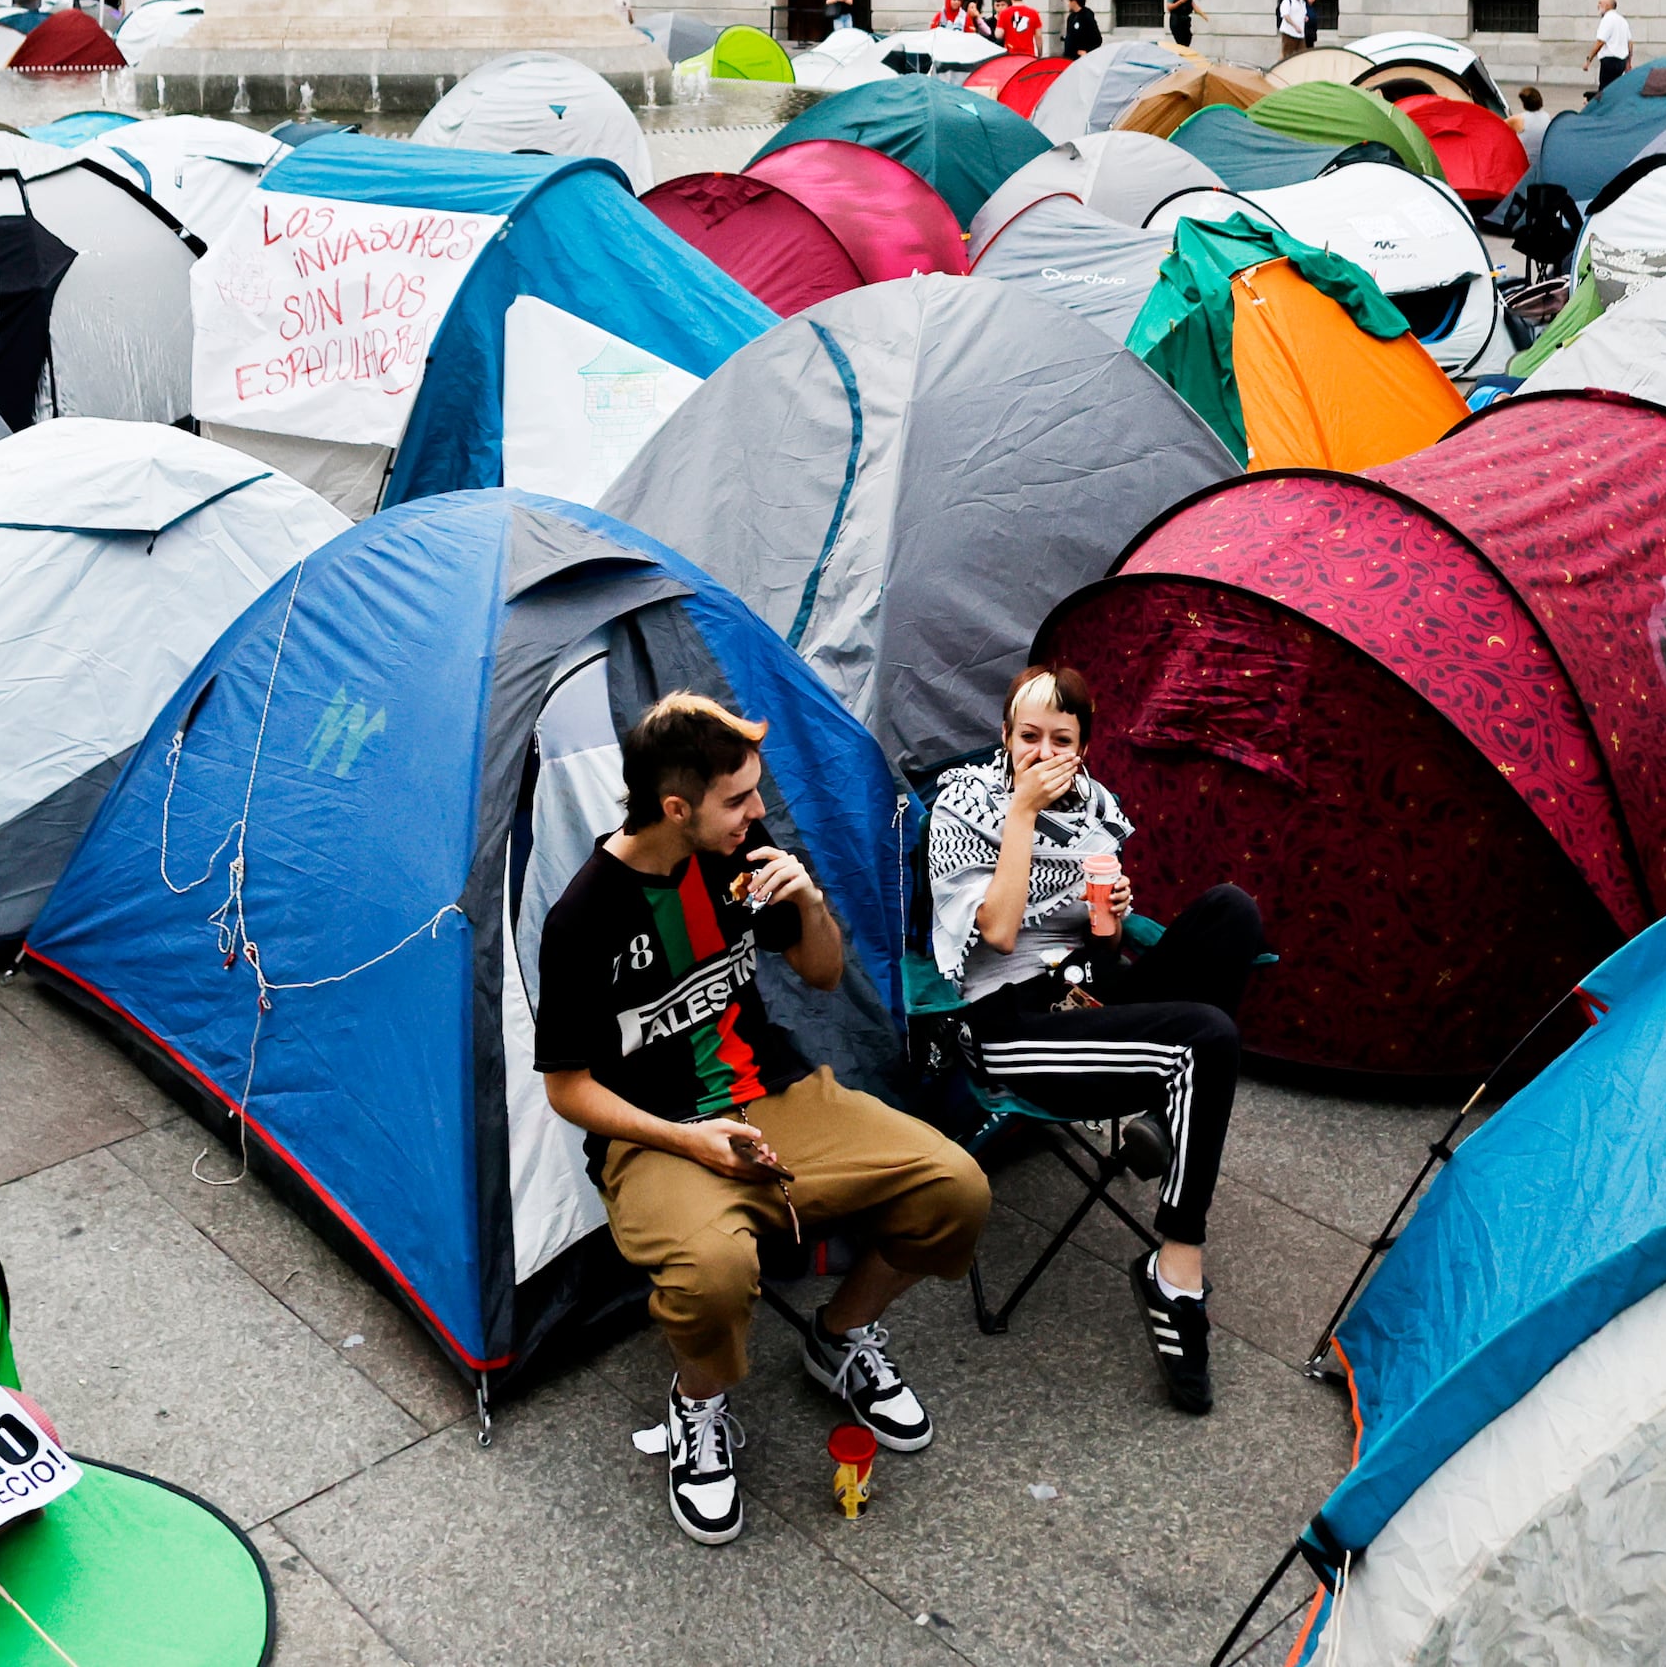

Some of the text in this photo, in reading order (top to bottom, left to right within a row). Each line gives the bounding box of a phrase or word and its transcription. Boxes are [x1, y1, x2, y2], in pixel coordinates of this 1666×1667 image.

[263, 204, 335, 246] LOS
[1040, 267, 1127, 285] Quechua
[279, 272, 425, 341] SON LOS
